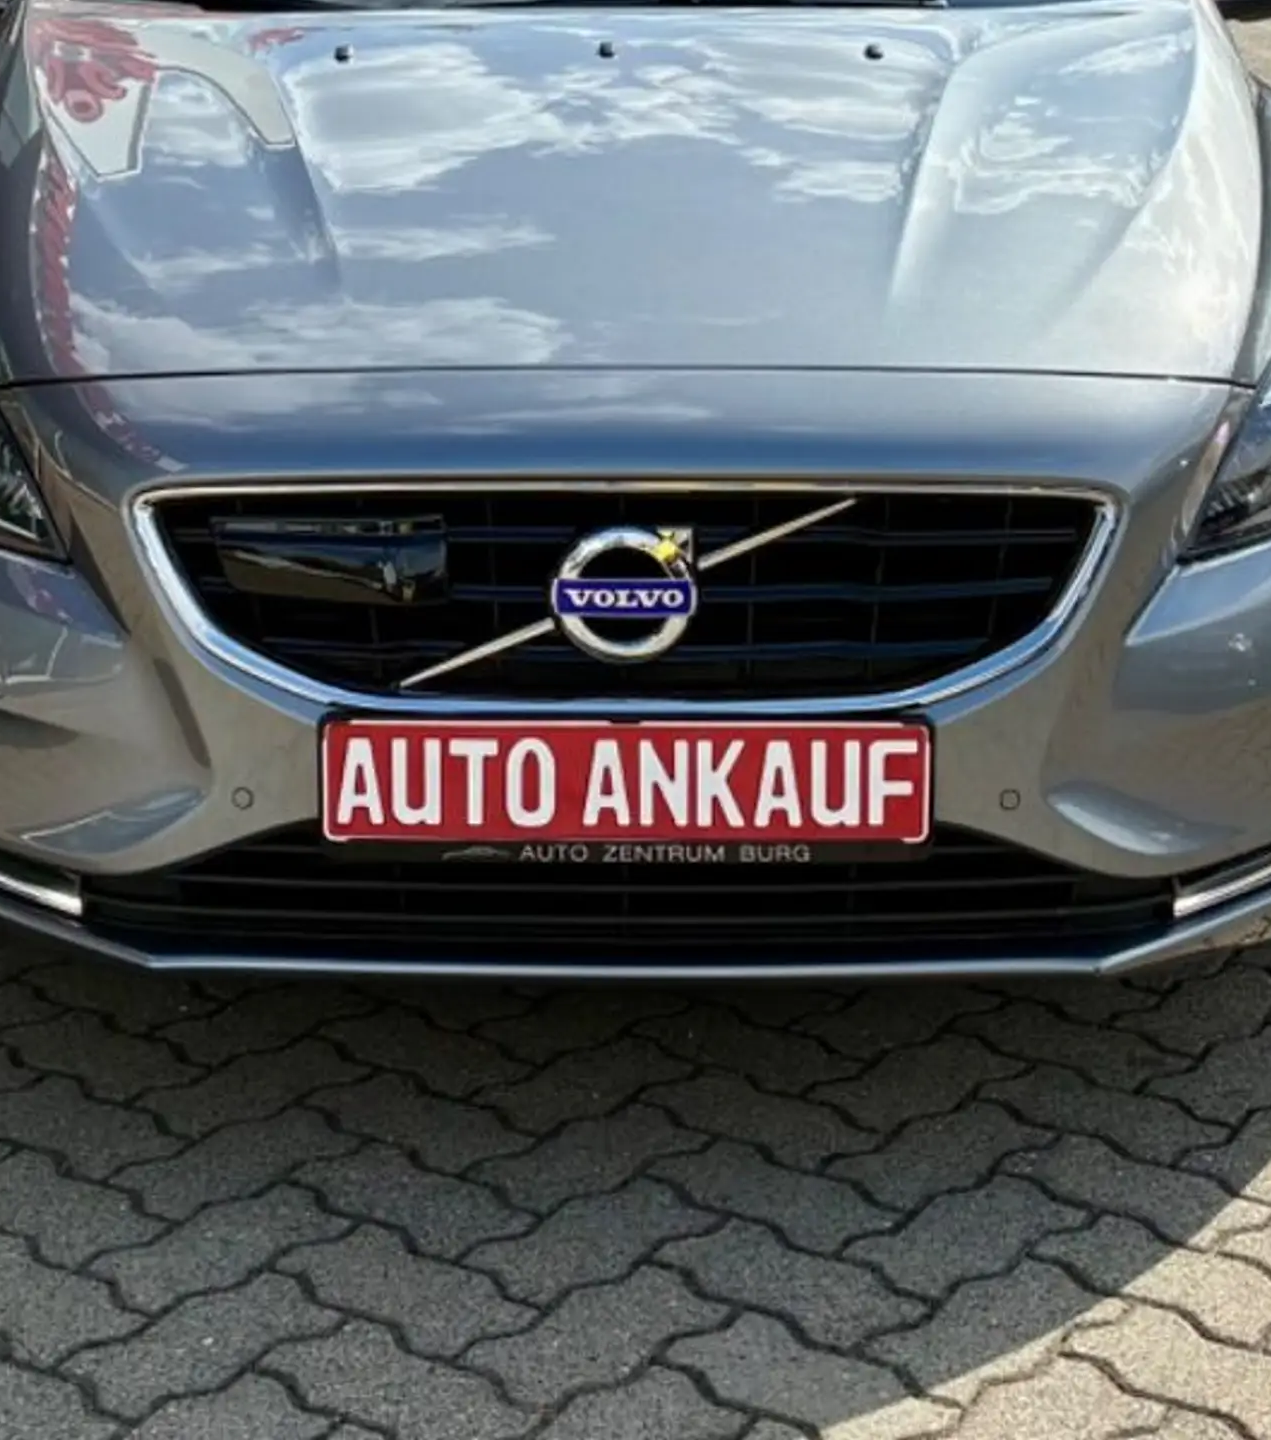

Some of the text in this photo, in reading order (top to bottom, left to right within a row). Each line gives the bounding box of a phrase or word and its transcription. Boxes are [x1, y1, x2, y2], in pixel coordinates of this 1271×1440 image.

[562, 587, 684, 609] VOLVO
[334, 736, 920, 829] AUTO ANKAUF
[518, 845, 811, 863] AUTO ZENTRUM BURG
